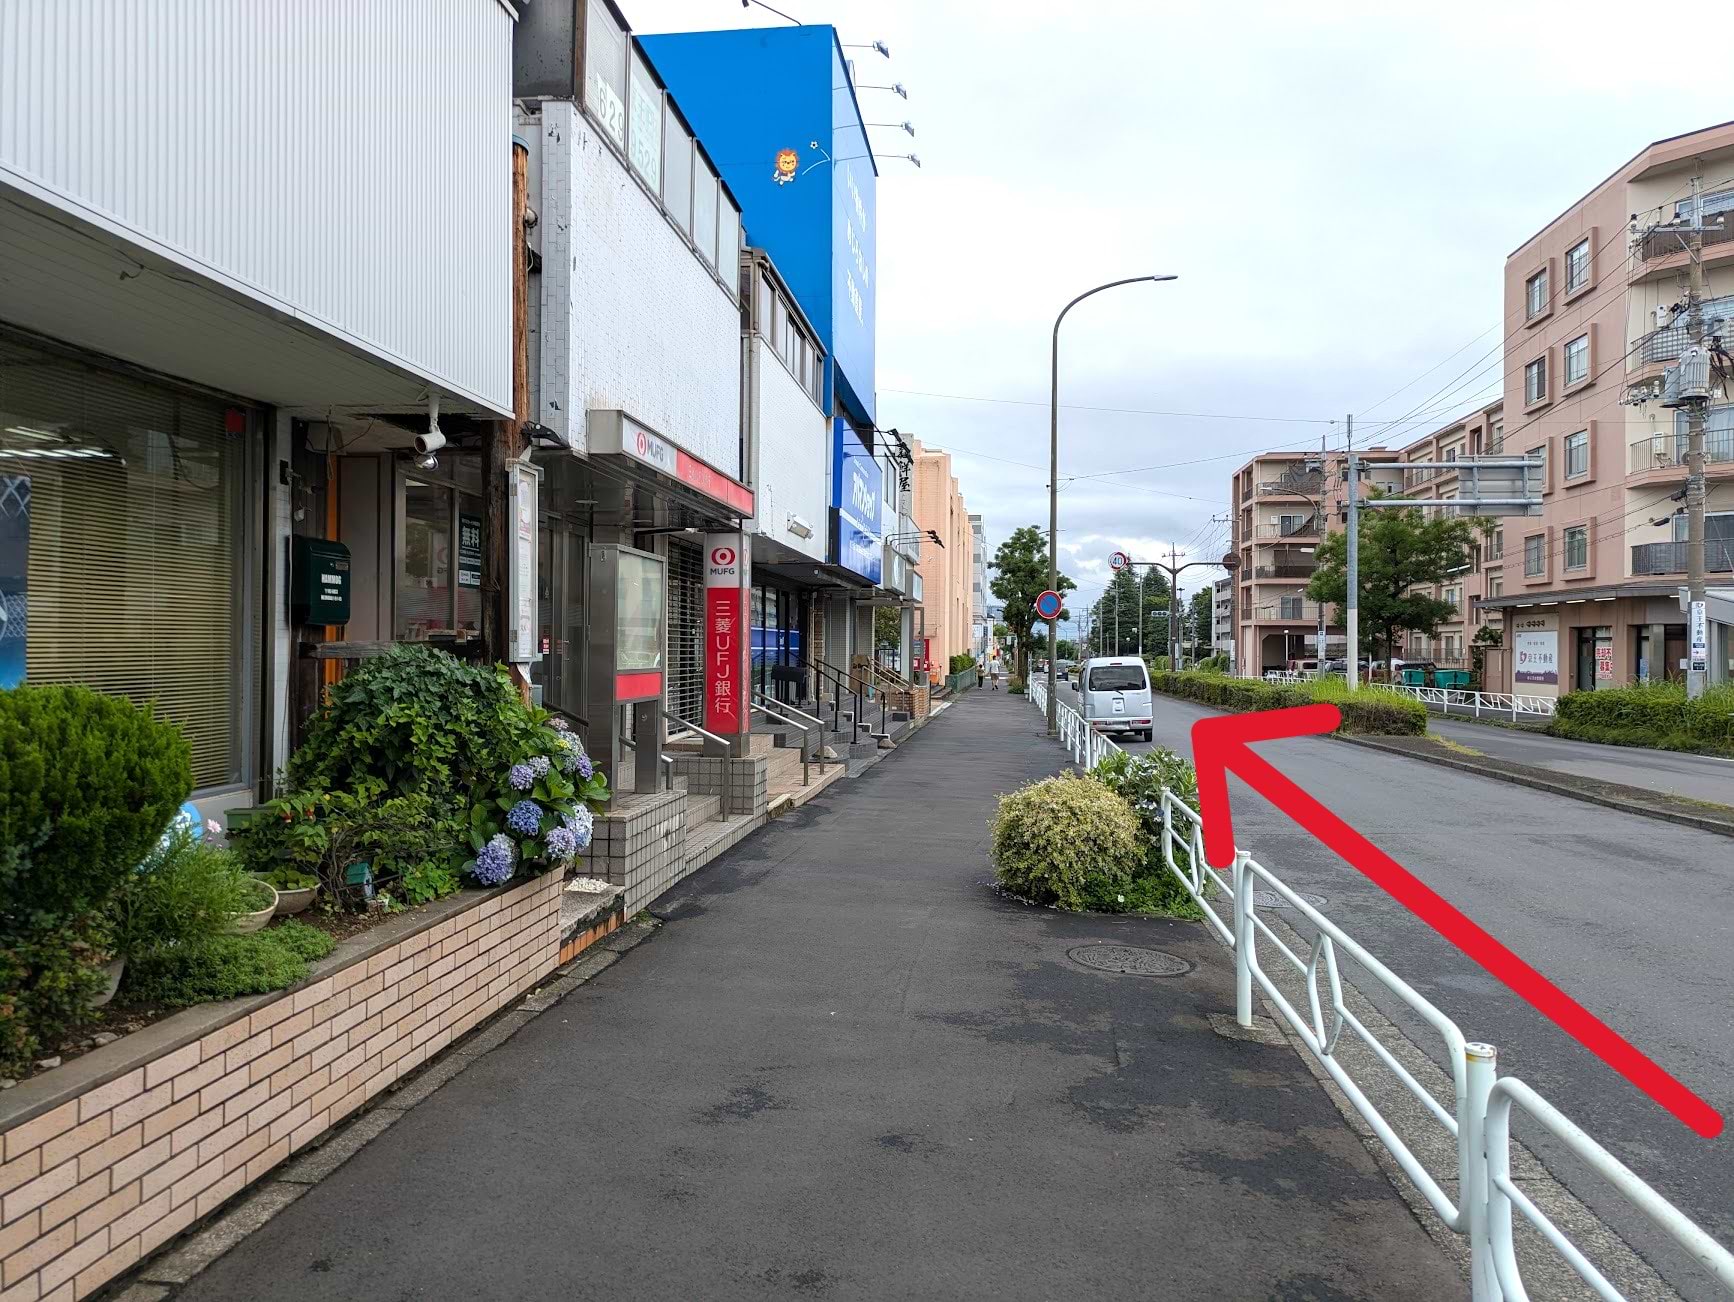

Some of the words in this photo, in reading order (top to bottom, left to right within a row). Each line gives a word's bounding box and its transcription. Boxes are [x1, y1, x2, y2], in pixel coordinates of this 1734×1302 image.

[647, 438, 664, 462] MUFG
[462, 526, 480, 548] 無料
[710, 567, 735, 576] MUFG
[1112, 556, 1123, 565] 40
[714, 600, 732, 714] 三菱UFJ銀行
